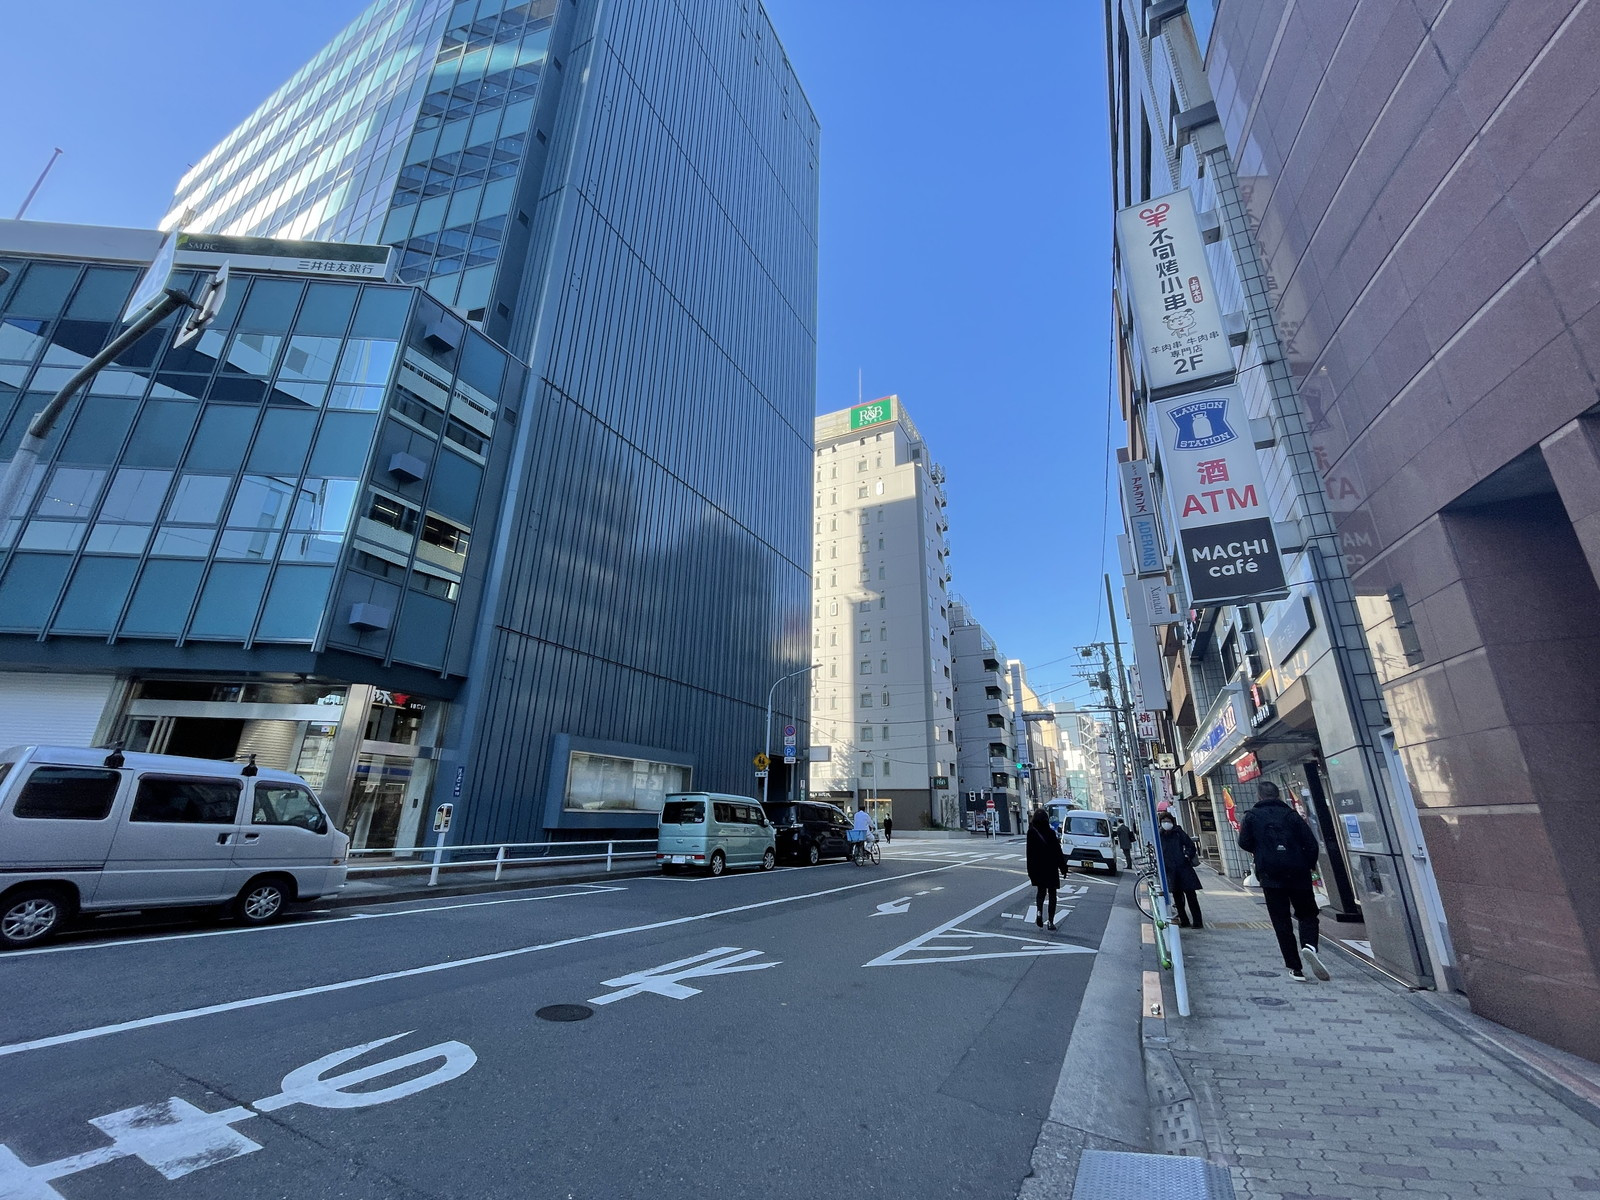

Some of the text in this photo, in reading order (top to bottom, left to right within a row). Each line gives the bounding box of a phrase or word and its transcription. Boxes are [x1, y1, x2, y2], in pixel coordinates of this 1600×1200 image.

[188, 241, 218, 251] SMBC
[296, 259, 376, 275] 三井住友銀行
[1148, 227, 1188, 312] 不同烤小串
[1150, 330, 1220, 355] 羊肉串 牛肉串
[1170, 344, 1203, 358] 専門店
[1173, 353, 1204, 375] 2F
[859, 405, 883, 422] R&B
[1172, 401, 1224, 418] LAWSON
[1180, 431, 1231, 448] STATION
[1196, 458, 1230, 485] 酒
[1131, 476, 1147, 513] アデランス
[1182, 484, 1259, 518] ATM
[1136, 520, 1157, 567] ADERANS
[1192, 538, 1269, 563] MACHI
[1209, 557, 1259, 577] café
